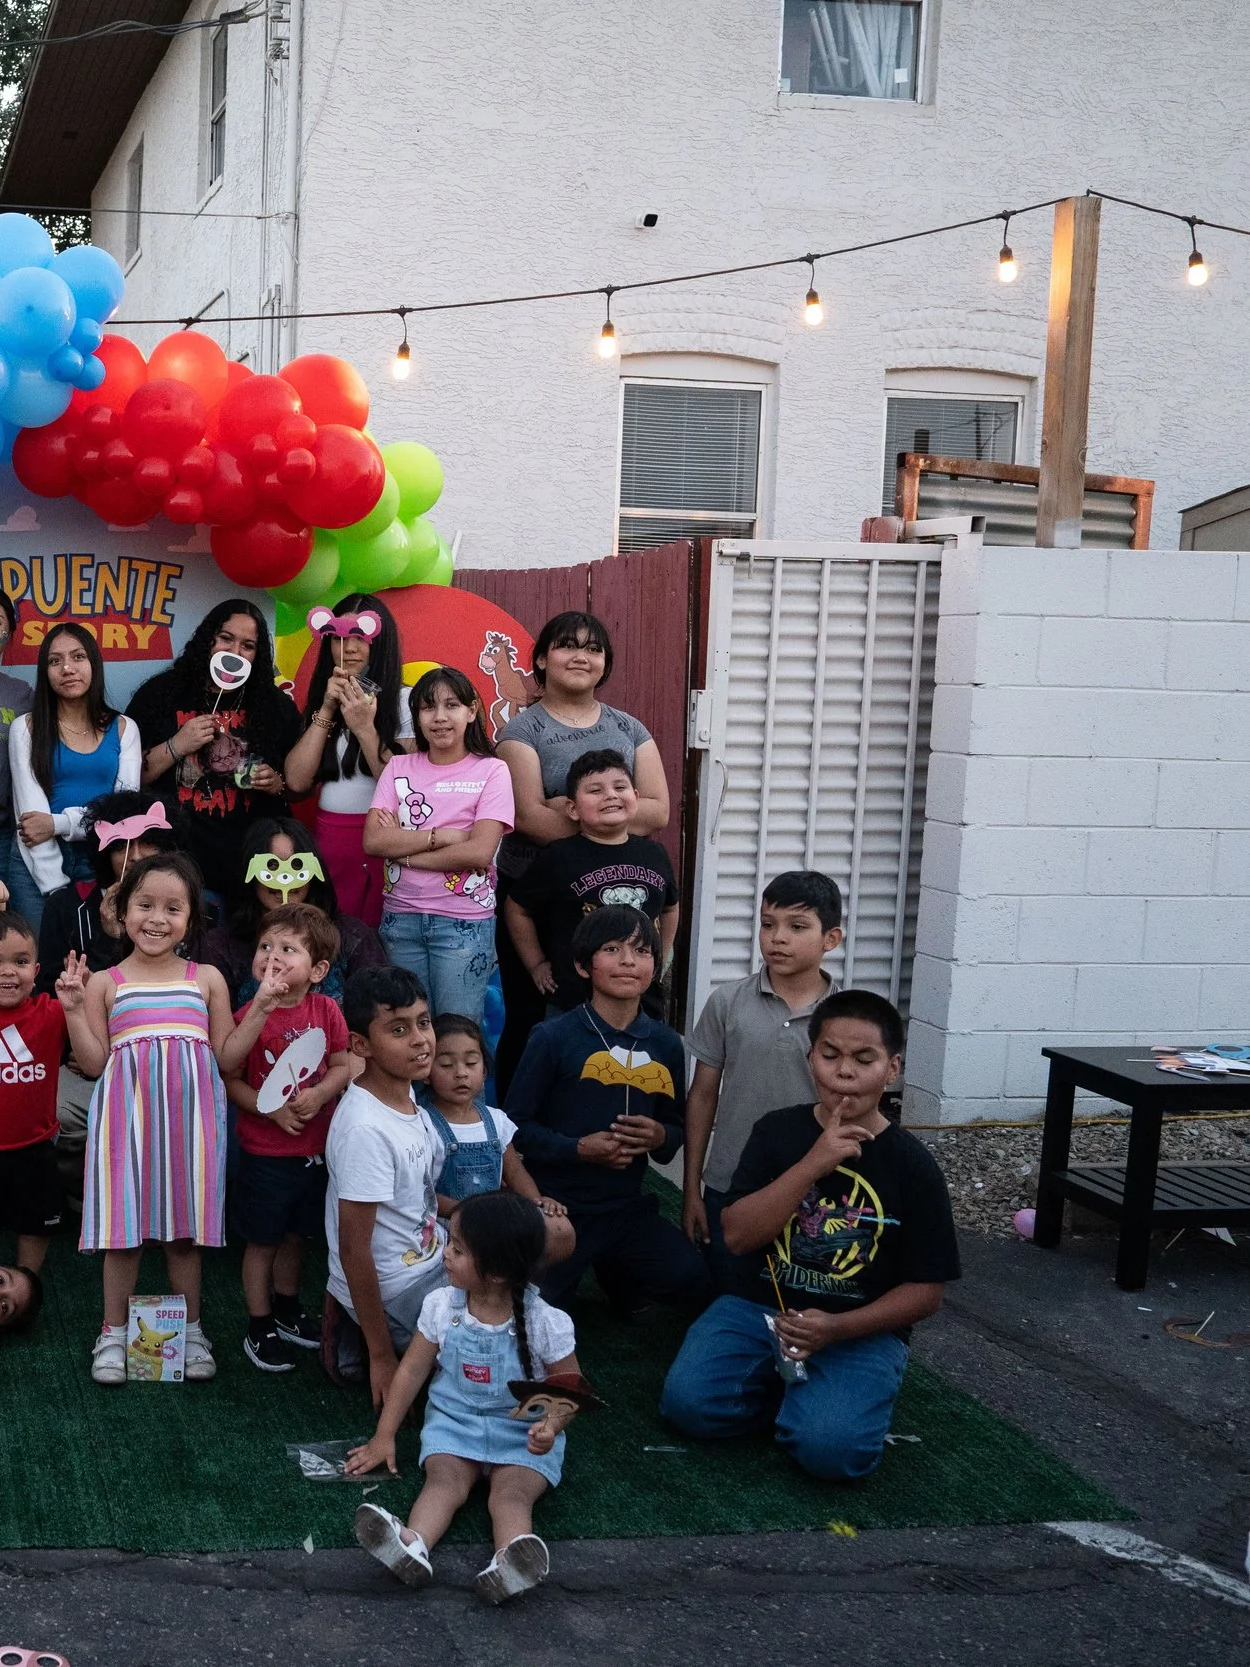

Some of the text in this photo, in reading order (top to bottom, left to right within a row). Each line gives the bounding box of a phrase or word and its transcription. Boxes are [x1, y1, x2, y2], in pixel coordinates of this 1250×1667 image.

[22, 620, 158, 649] SRY
[570, 864, 665, 896] LEGENDARY
[156, 1310, 185, 1320] SPEED
[156, 1320, 184, 1331] PUSH
